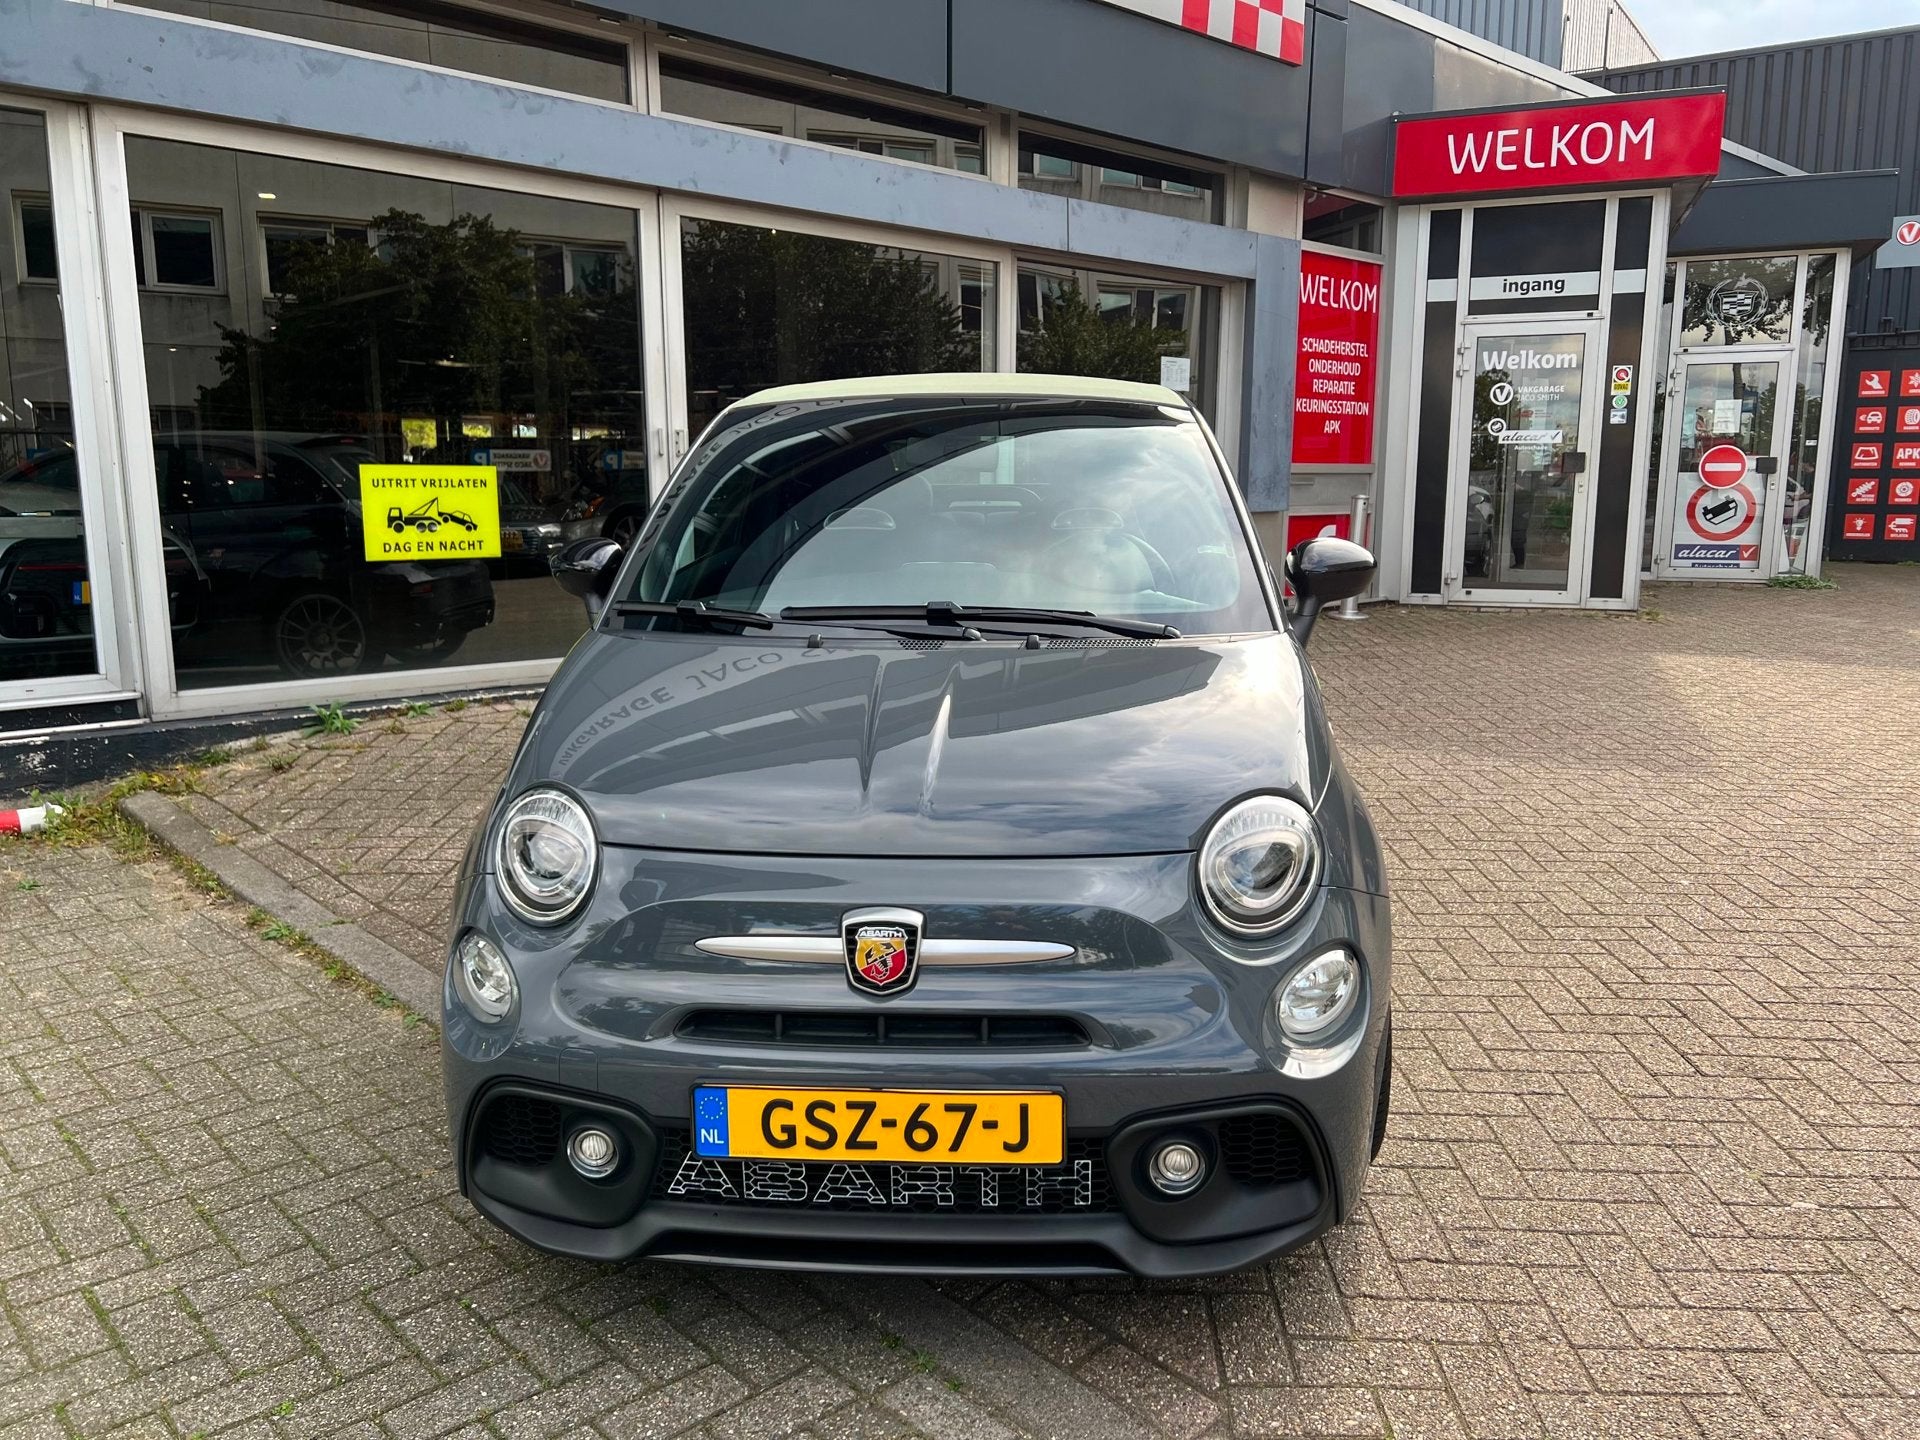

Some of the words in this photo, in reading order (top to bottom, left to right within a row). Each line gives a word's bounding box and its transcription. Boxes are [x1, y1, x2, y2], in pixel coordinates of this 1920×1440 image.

[1447, 117, 1655, 174] WELKOM
[1300, 272, 1377, 313] WELKOM
[1503, 278, 1565, 296] ingang
[1302, 337, 1368, 358] SCHADEHERSTEL
[1308, 358, 1361, 376] ONDERHOUD
[1482, 349, 1577, 370] Welkom
[1312, 379, 1356, 395] REPARATIE
[1518, 385, 1565, 393] VAKGARAGE
[1515, 393, 1535, 401] JACO
[1537, 393, 1560, 401] SMITH
[1296, 398, 1369, 416] KEURINGSSTATION
[1324, 420, 1341, 434] APK
[1896, 447, 1920, 460] APK
[372, 479, 417, 488] UITRIT
[421, 478, 487, 488] VRIJLATEN
[383, 542, 412, 553] DAG
[417, 542, 434, 552] EN
[440, 540, 484, 551] NACHT
[1678, 545, 1737, 558] alacar
[860, 930, 902, 938] ABARTH
[760, 1098, 1030, 1153] GSZ-67-J
[701, 1128, 724, 1144] NL
[667, 1151, 1092, 1205] ABARTH
